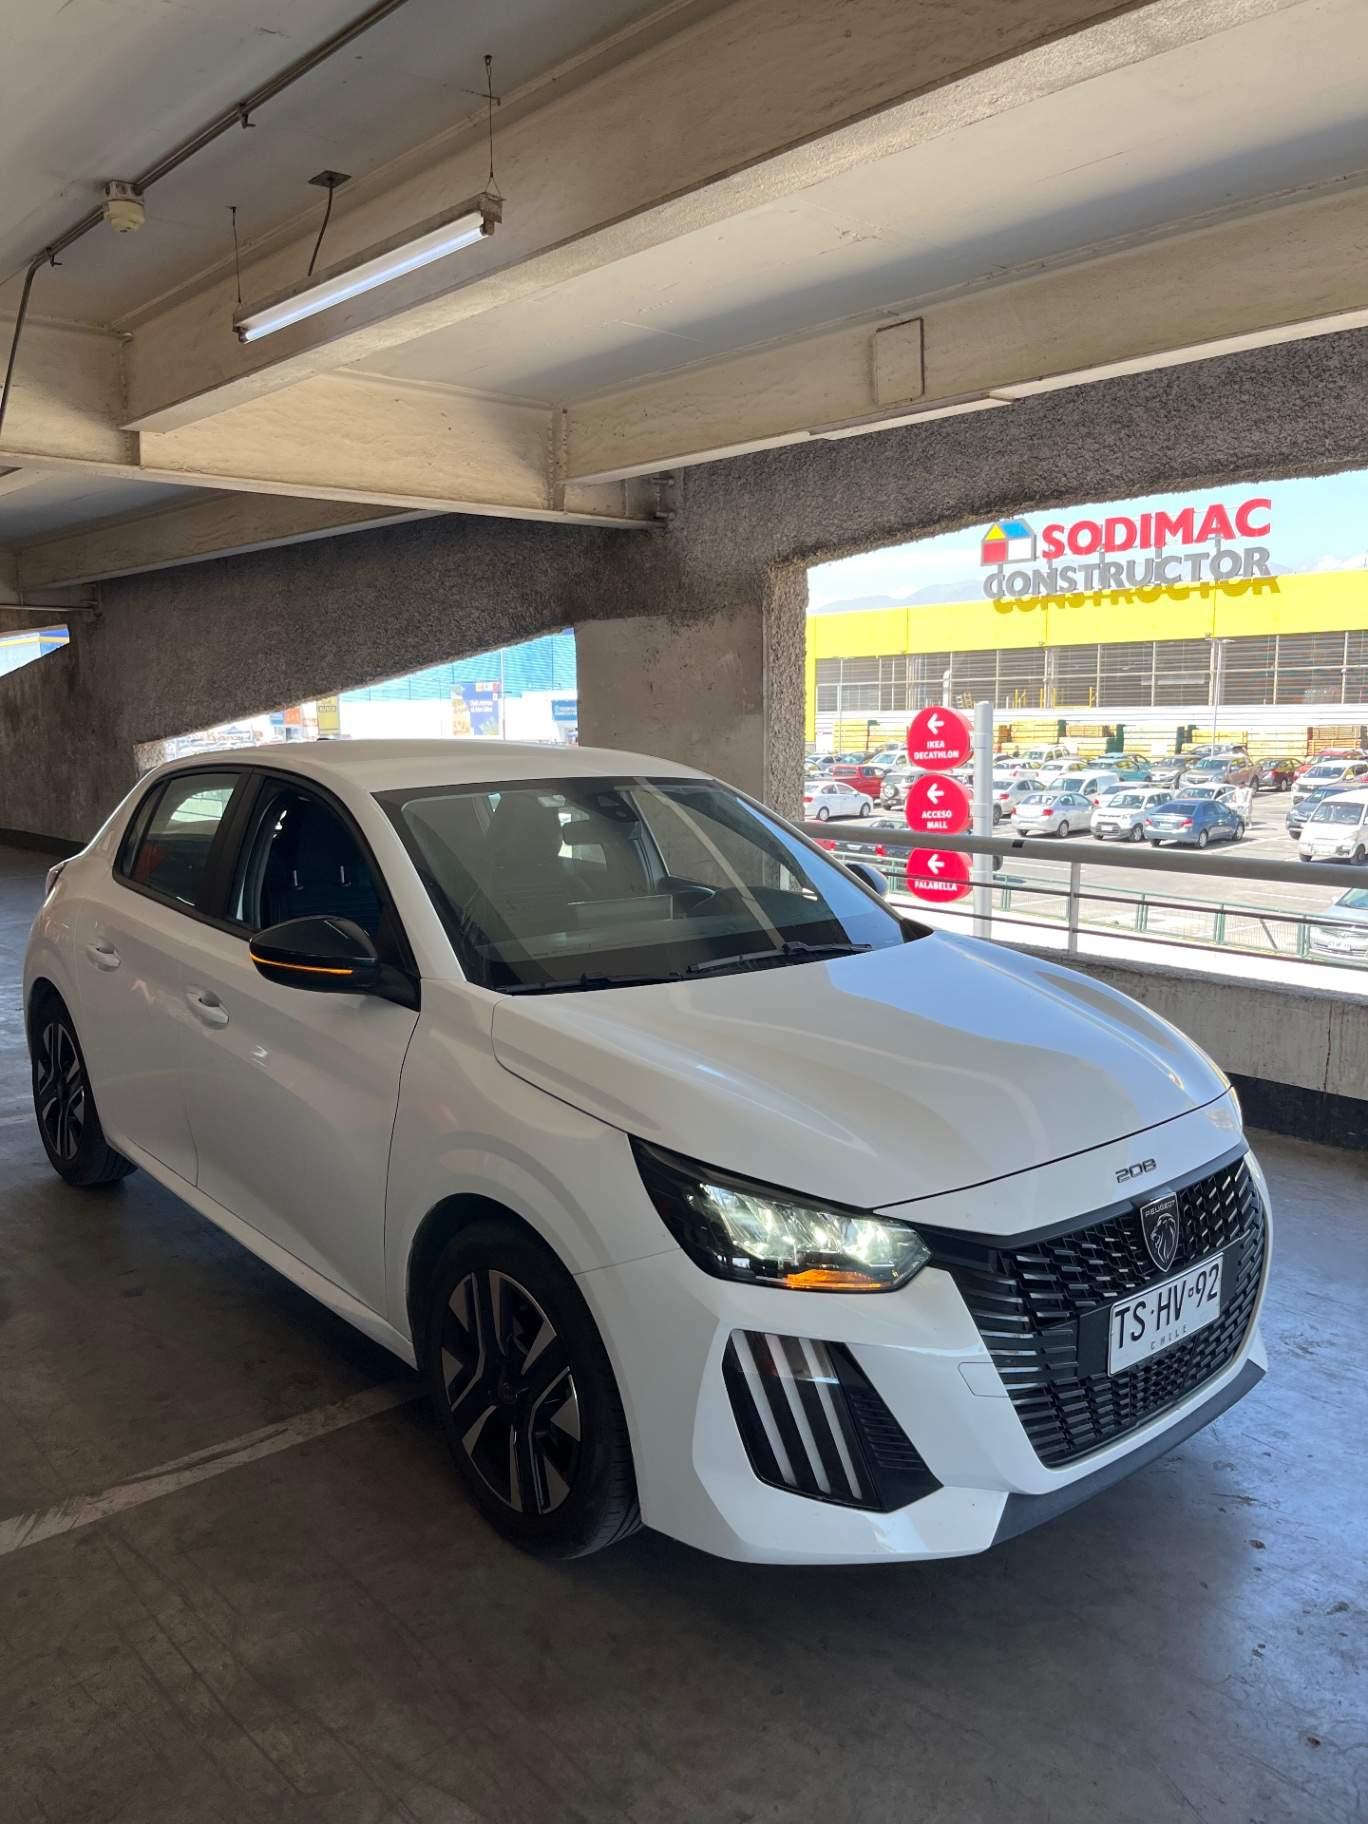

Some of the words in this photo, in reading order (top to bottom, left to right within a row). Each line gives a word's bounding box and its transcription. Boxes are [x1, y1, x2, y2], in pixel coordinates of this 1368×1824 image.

[1042, 498, 1272, 560] SODIMAC
[983, 546, 1271, 599] CONSTRUCTOR
[927, 741, 944, 749] IKEA
[914, 750, 959, 760] DECATHLON
[921, 810, 952, 819] ACCESO
[926, 821, 948, 829] MALL
[914, 880, 957, 891] FALABELLA
[1115, 1158, 1157, 1183] 208
